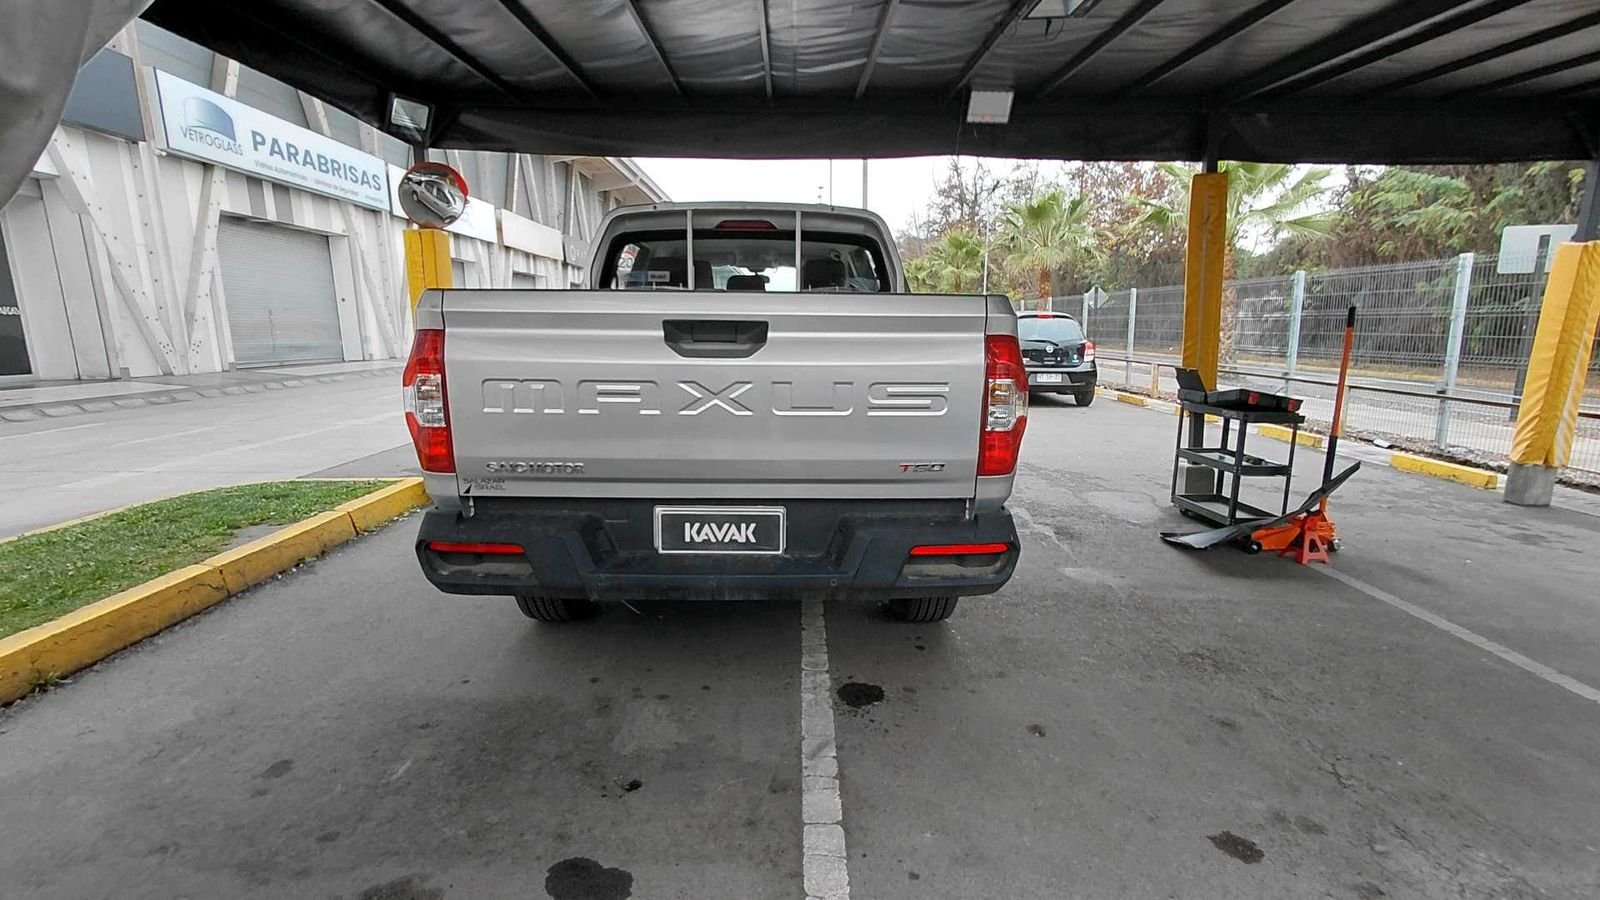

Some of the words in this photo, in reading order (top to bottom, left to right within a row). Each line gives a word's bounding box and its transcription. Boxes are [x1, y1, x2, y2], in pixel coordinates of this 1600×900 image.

[180, 125, 243, 156] VETROGLASS
[251, 130, 382, 192] PARABRISAS
[481, 378, 950, 416] MAXUS
[486, 461, 527, 473] SAIC
[527, 462, 585, 474] MOTOR
[684, 522, 757, 543] KAVAK
